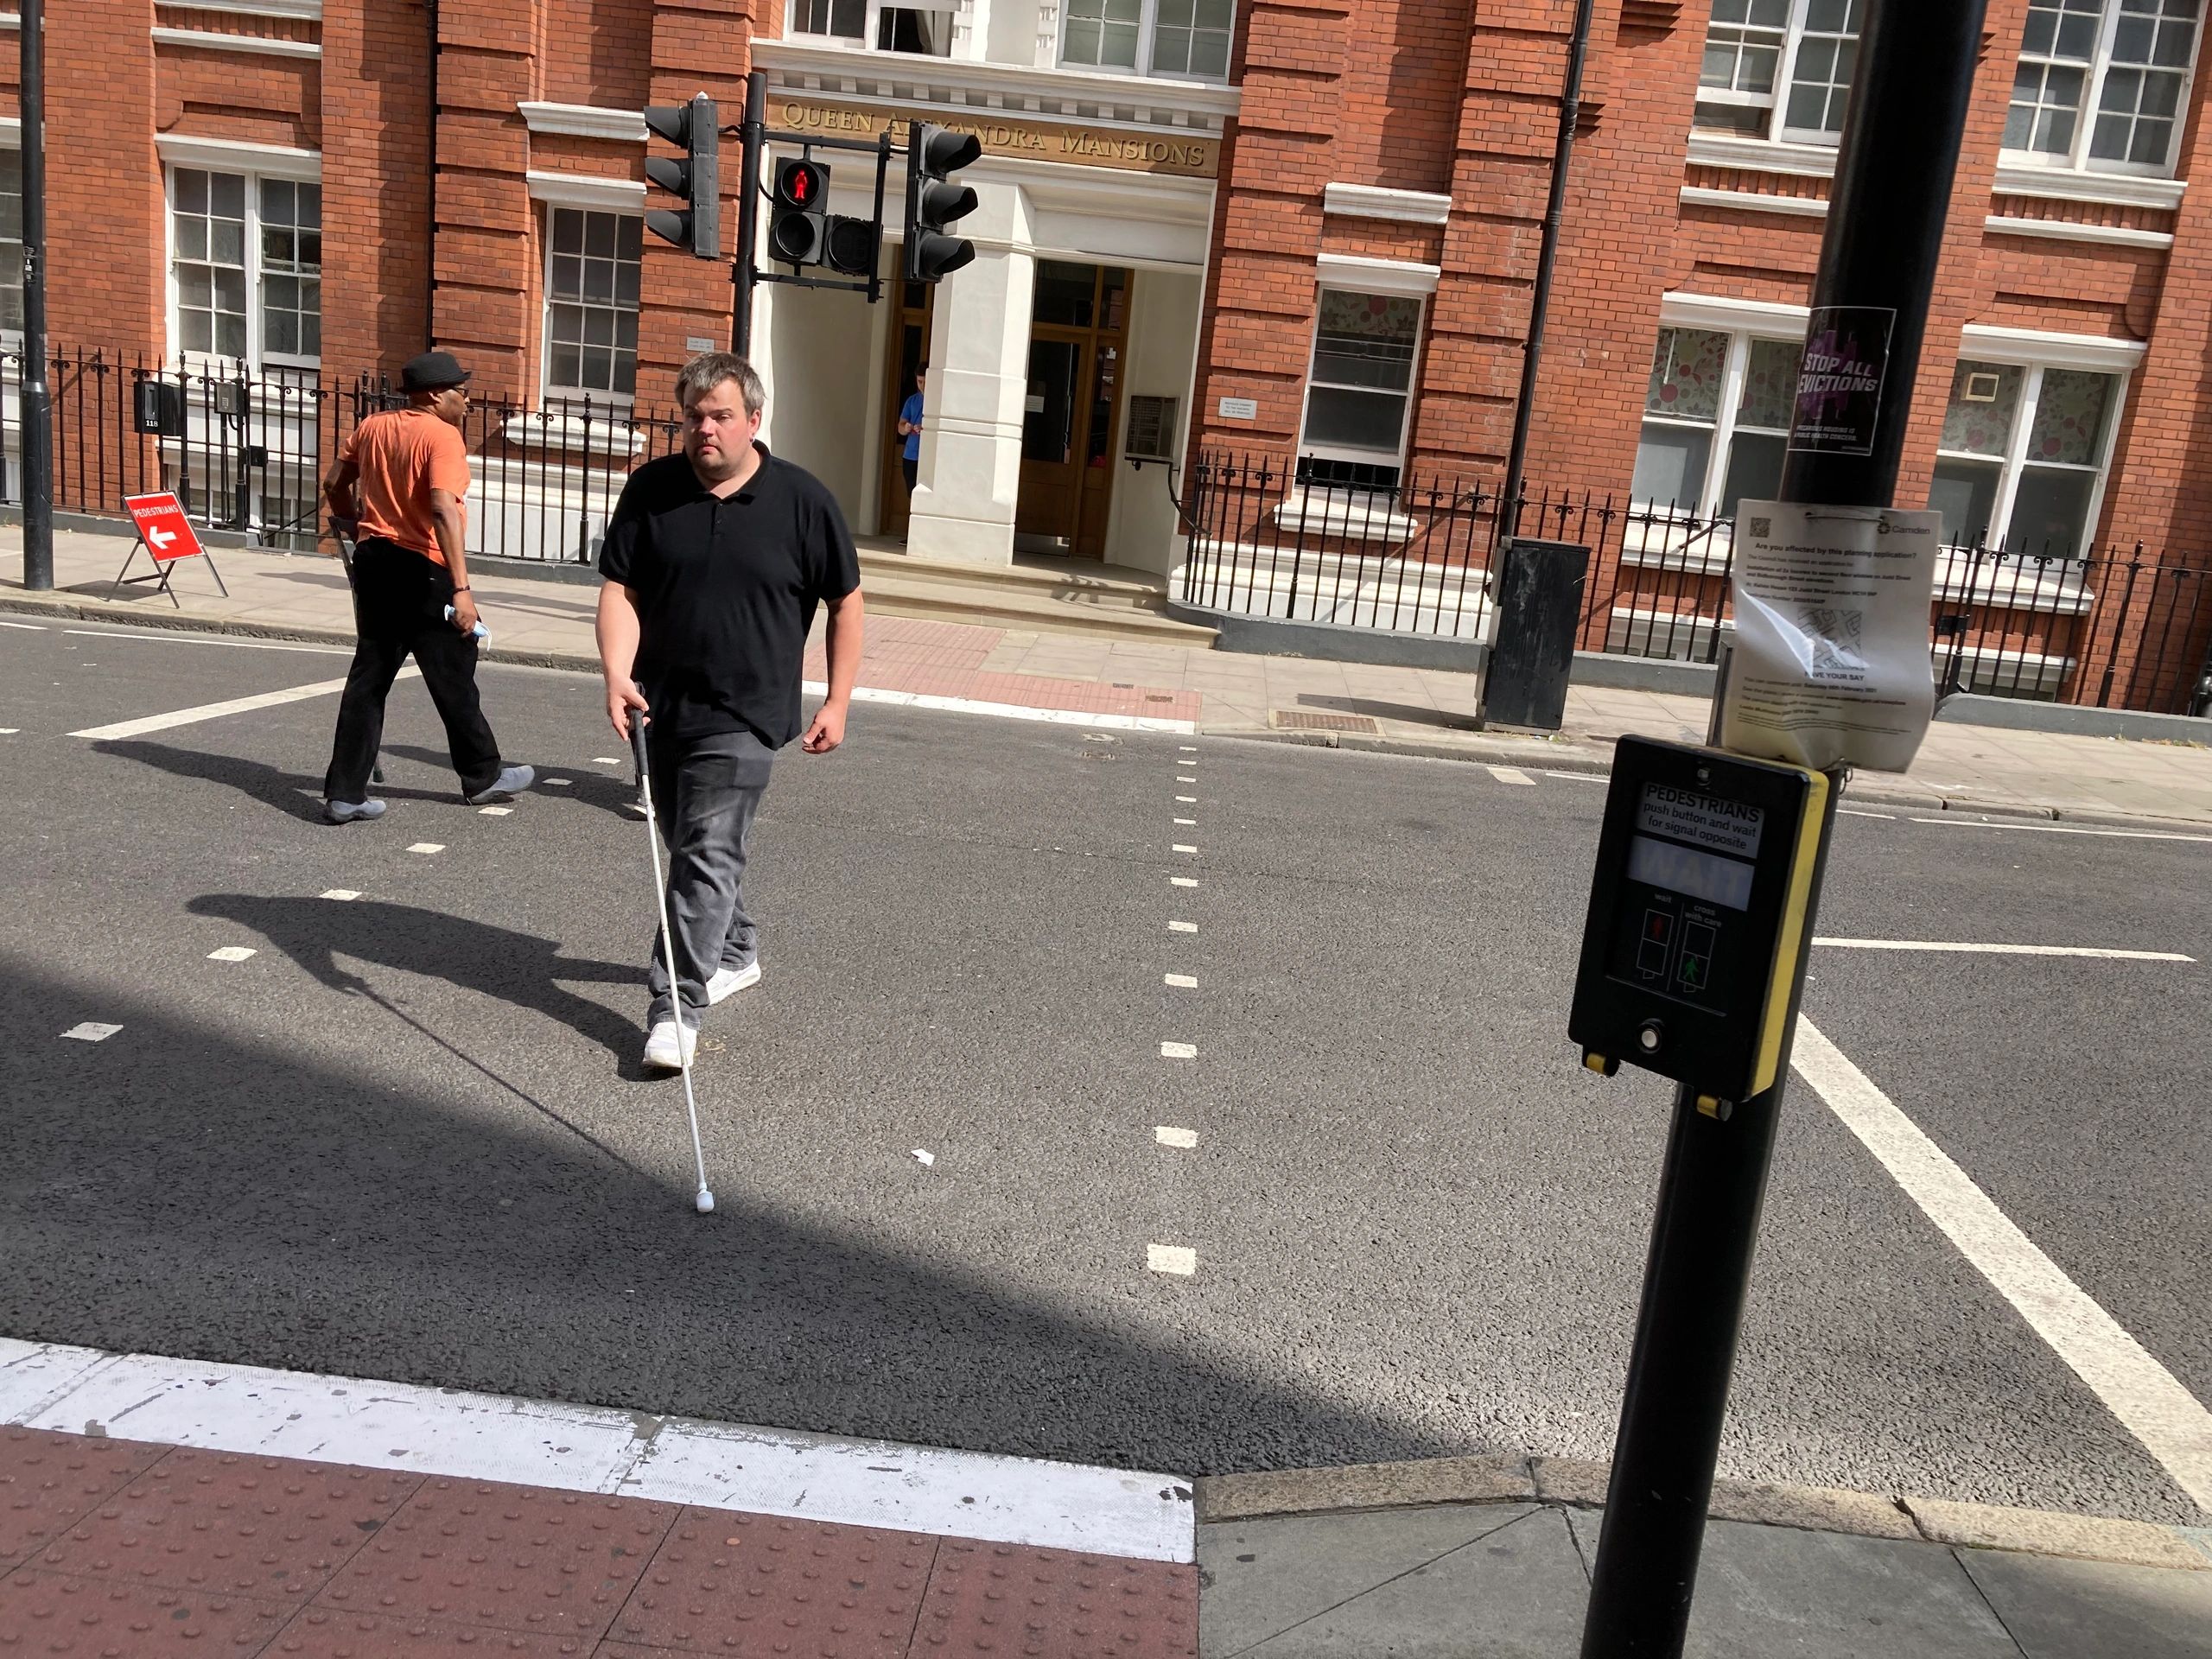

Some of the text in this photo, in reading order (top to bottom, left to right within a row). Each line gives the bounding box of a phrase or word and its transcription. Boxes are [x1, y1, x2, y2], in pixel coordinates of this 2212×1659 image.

[782, 102, 1205, 166] QUEEN ALANDRA MANSIONS
[1804, 353, 1872, 377] STOP ALL
[1798, 374, 1878, 394] EVICTIONS
[132, 505, 179, 518] PEDESTRIANS
[1892, 525, 1930, 534] Camden
[1817, 547, 1827, 556] by
[1844, 550, 1872, 558] planning
[1646, 785, 1760, 823] PEDESTRIANS
[1643, 802, 1757, 837] push button and wait
[1648, 816, 1747, 849] for signal opposite
[1638, 844, 1749, 905] WAIT
[1655, 893, 1673, 904] wait
[1685, 912, 1722, 928] with care
[1694, 905, 1716, 916] cross
